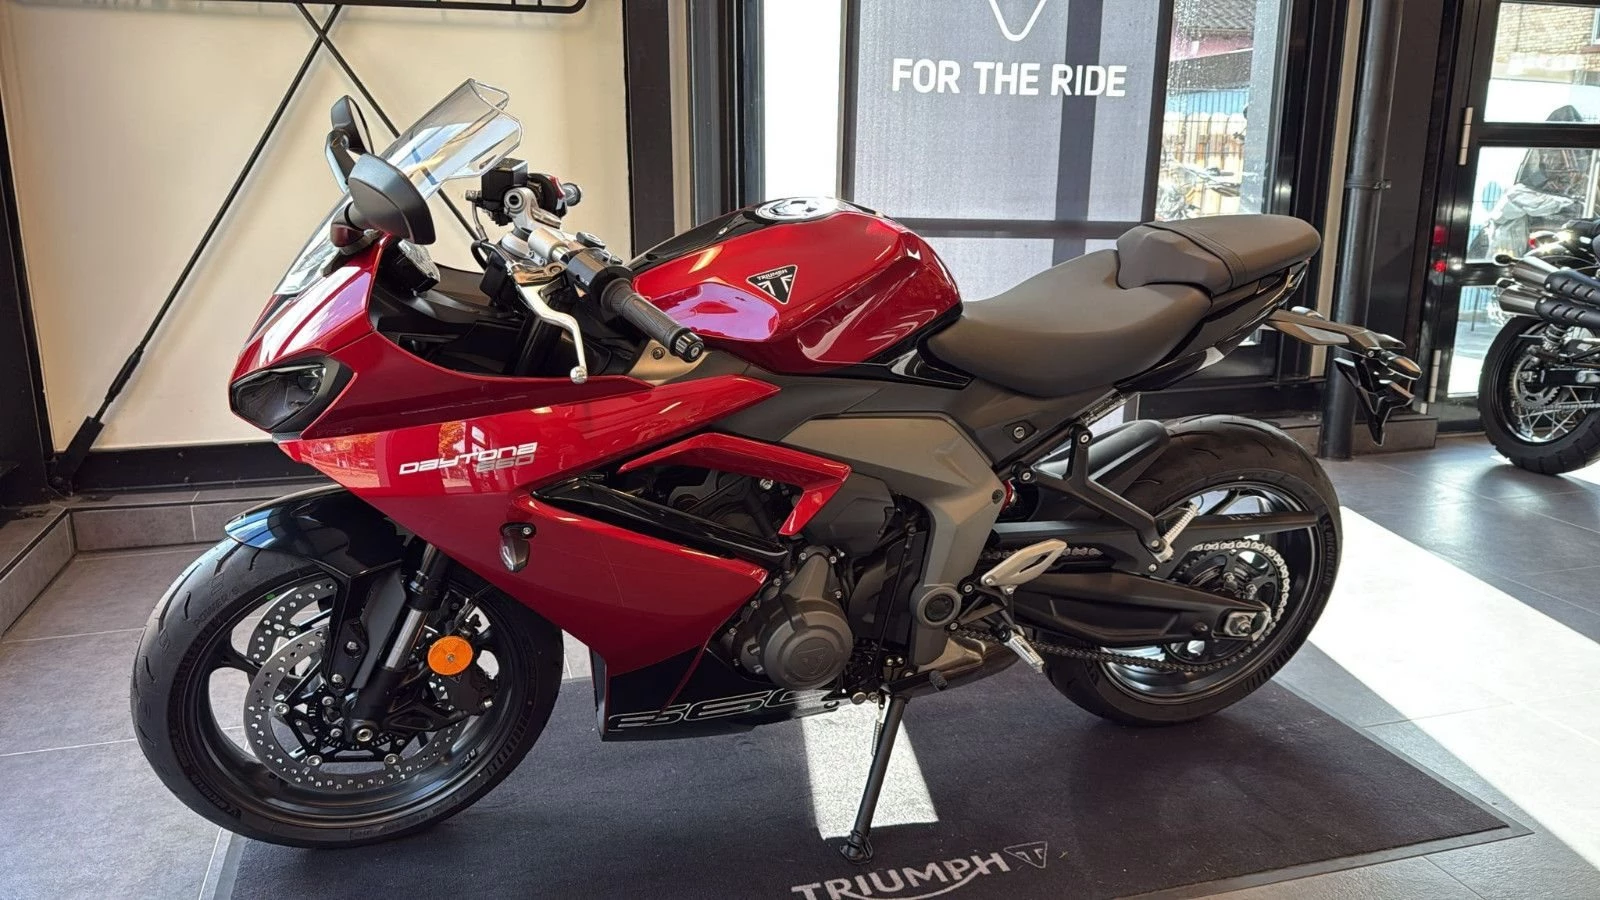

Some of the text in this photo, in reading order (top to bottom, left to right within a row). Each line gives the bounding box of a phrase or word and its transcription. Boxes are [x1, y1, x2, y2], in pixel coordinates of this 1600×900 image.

[892, 58, 1127, 97] FOR THE RIDE
[757, 269, 788, 280] TRIUMPH
[476, 454, 535, 473] 660
[791, 852, 1012, 900] TRIUMPH
